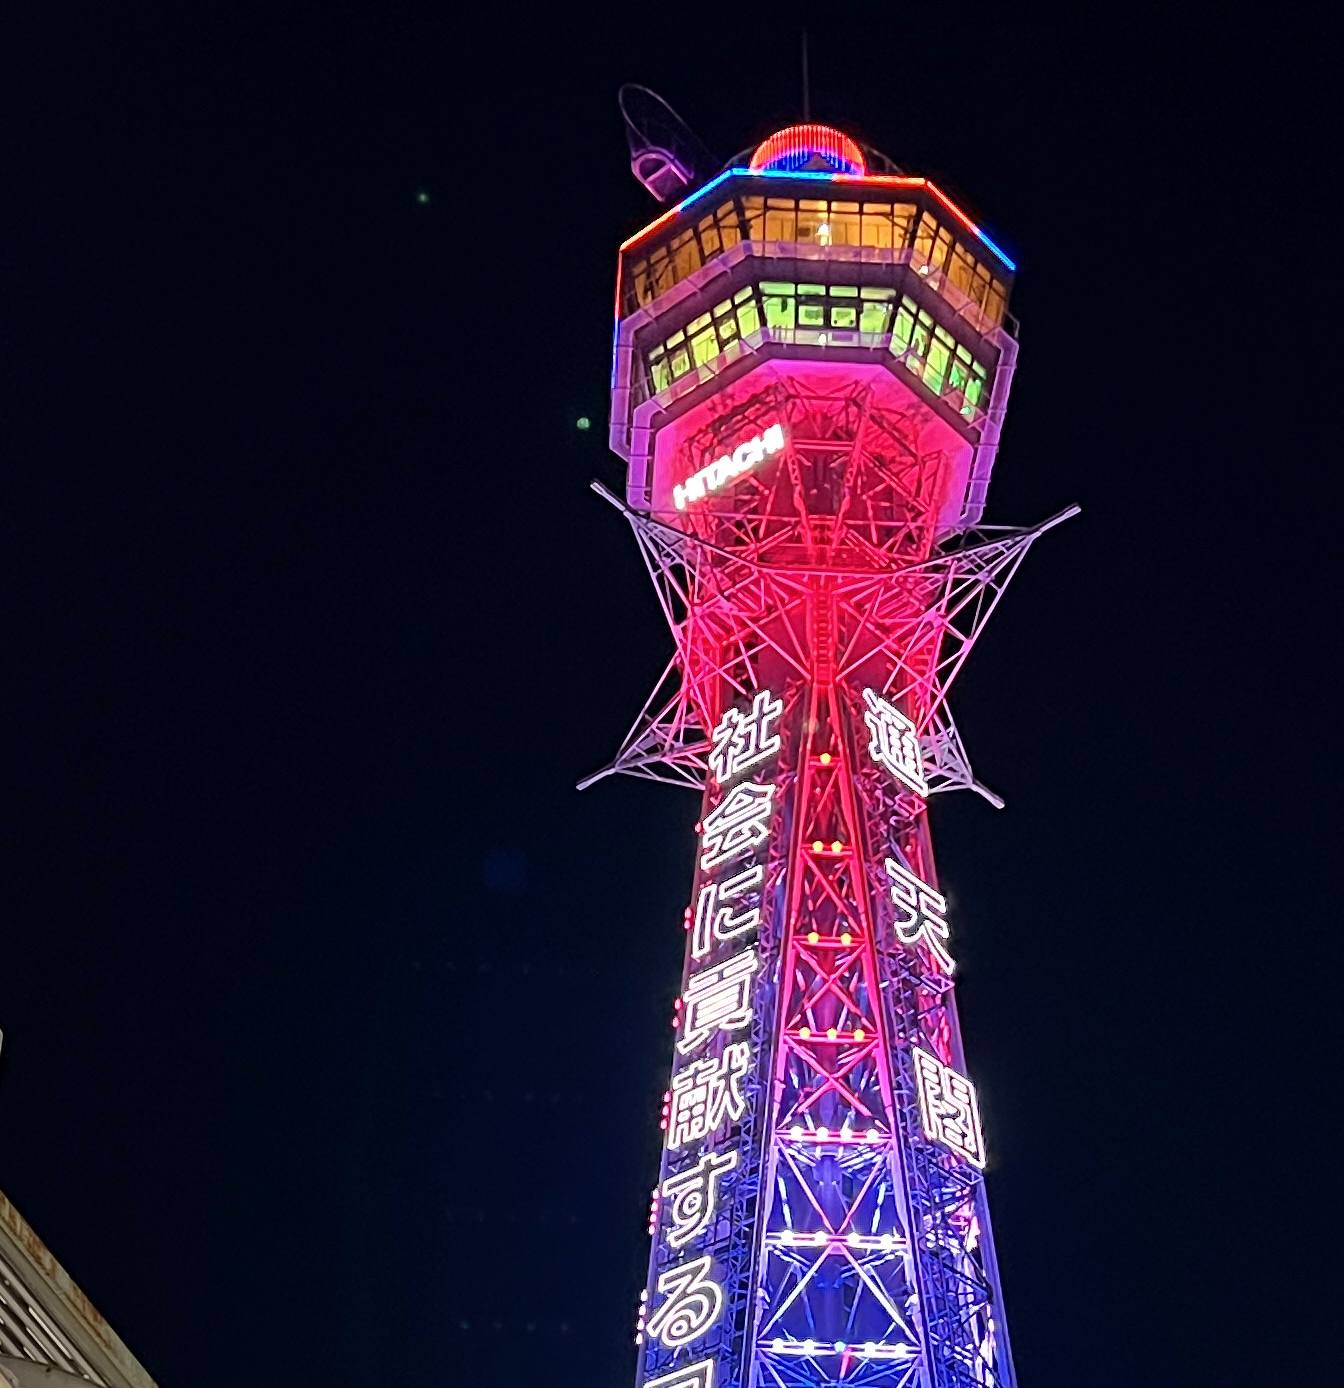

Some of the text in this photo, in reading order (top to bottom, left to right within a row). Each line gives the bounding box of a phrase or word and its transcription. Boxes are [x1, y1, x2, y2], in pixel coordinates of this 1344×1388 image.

[674, 423, 786, 512] HITACHI
[863, 687, 987, 1169] 通天閣
